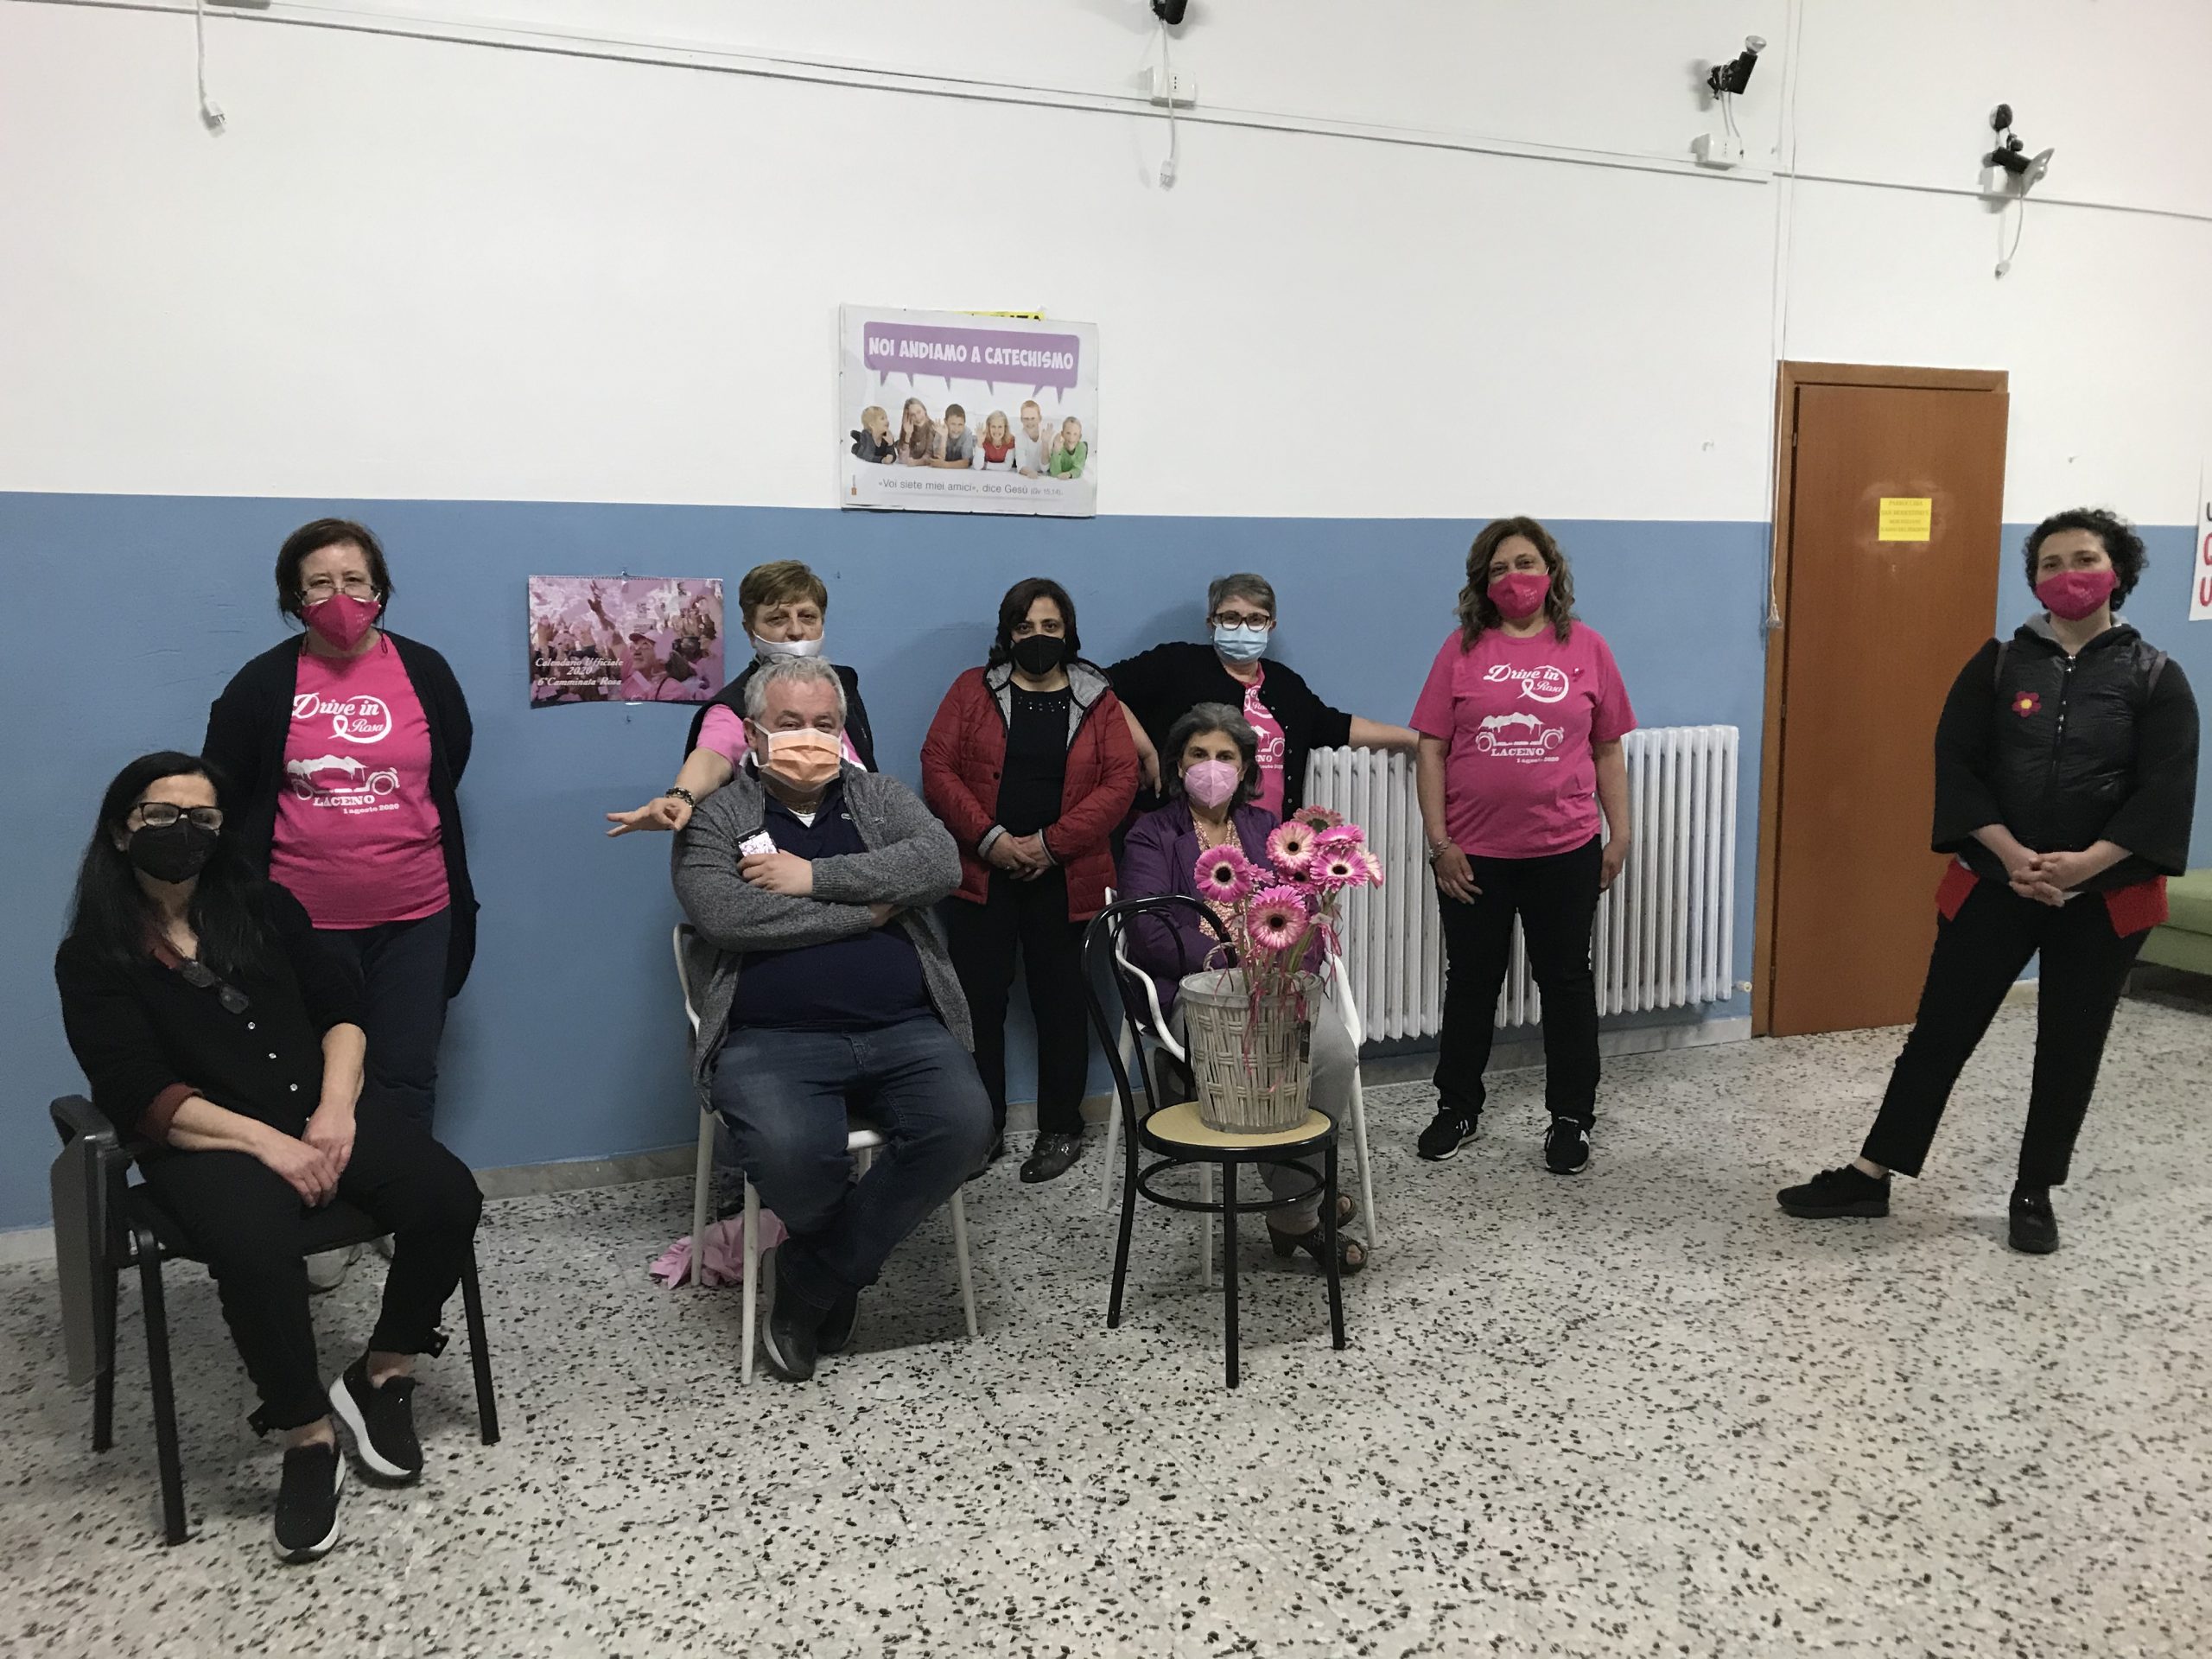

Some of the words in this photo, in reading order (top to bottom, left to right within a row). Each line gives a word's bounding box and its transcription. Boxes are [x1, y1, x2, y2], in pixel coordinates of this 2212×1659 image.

[868, 337, 894, 356] NOI
[899, 340, 967, 362] ANDIAMO
[971, 346, 982, 363] A
[985, 347, 1074, 370] CATECHISMO
[899, 480, 923, 490] siete
[925, 481, 944, 491] miei
[982, 484, 1001, 493] dice
[1004, 484, 1028, 494] Gesù
[536, 658, 582, 666] Calendario
[1483, 664, 1541, 682] Drive
[1543, 669, 1560, 681] in
[600, 677, 622, 685] Rosa
[1533, 681, 1562, 693] Rosa
[292, 692, 356, 719] Drive
[359, 700, 379, 716] in
[347, 719, 385, 733] Rosa
[1491, 747, 1545, 757] LACENO
[313, 795, 375, 807] LACENO
[378, 803, 400, 811] 2020
